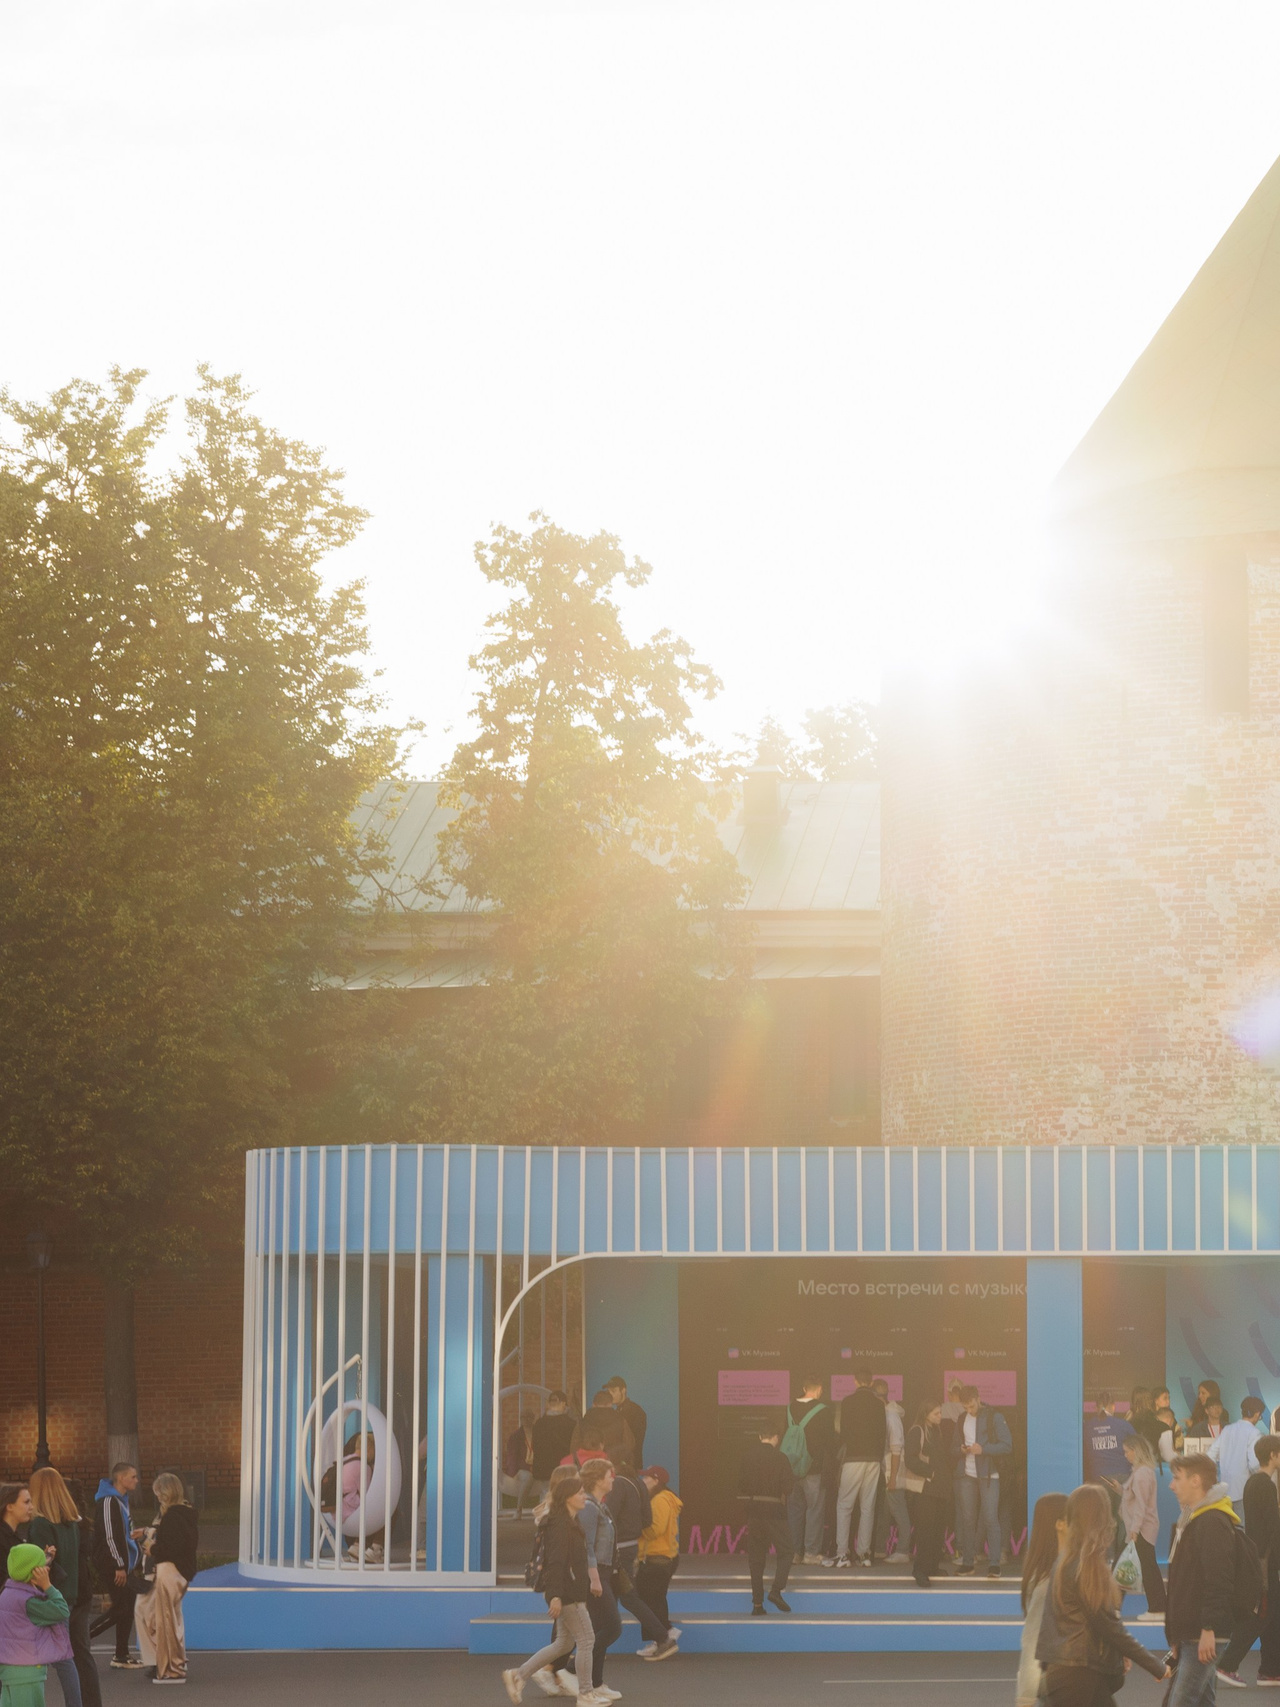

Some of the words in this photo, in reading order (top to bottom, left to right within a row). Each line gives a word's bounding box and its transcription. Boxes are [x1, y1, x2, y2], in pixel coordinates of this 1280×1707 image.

[798, 1280, 860, 1296] Место
[865, 1282, 943, 1299] встречи
[949, 1283, 959, 1296] с
[965, 1283, 1027, 1299] музык
[866, 1350, 893, 1358] Музыка
[979, 1350, 1007, 1358] Музыка
